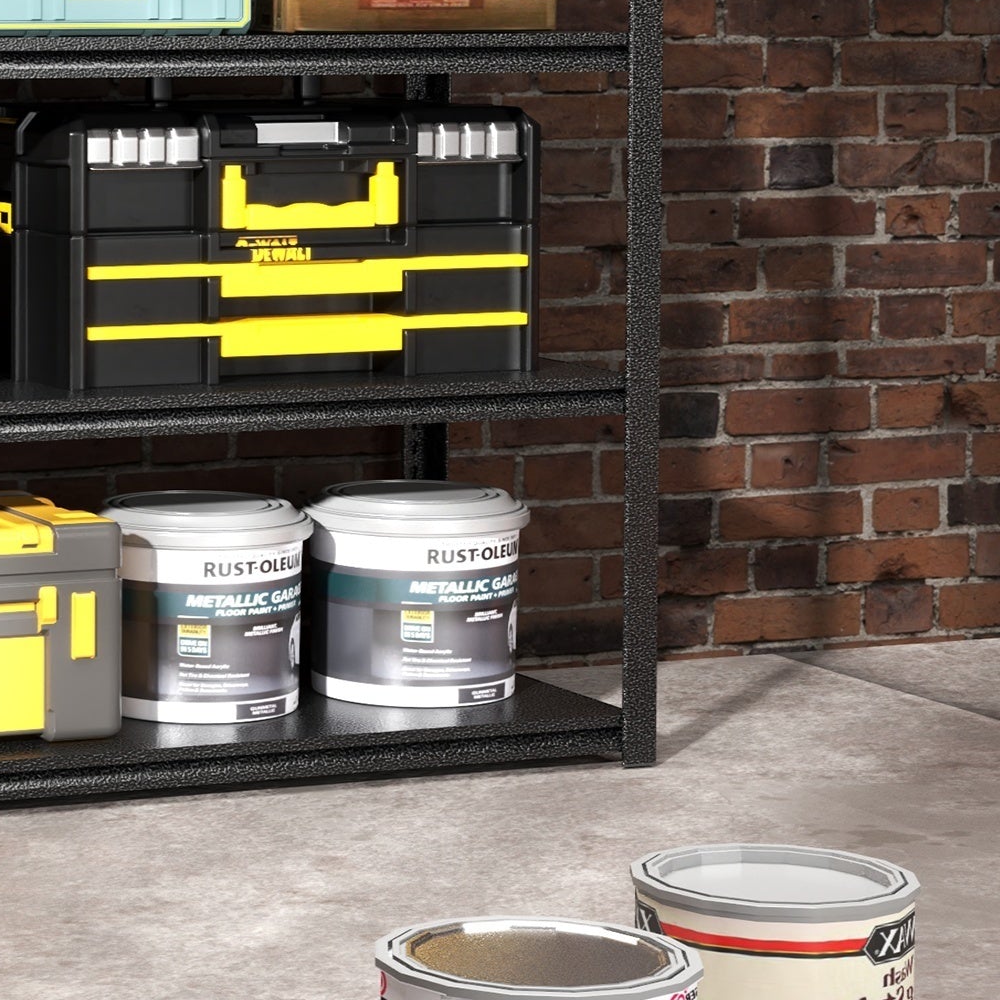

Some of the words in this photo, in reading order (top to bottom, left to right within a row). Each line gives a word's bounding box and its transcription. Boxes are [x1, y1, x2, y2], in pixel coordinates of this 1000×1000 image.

[409, 579, 490, 593] METALLIC
[186, 592, 269, 608] METALLIC
[438, 595, 469, 603] FLOOR
[470, 592, 493, 600] PAINT
[215, 609, 246, 617] FLOOR
[248, 606, 272, 615] PAINT
